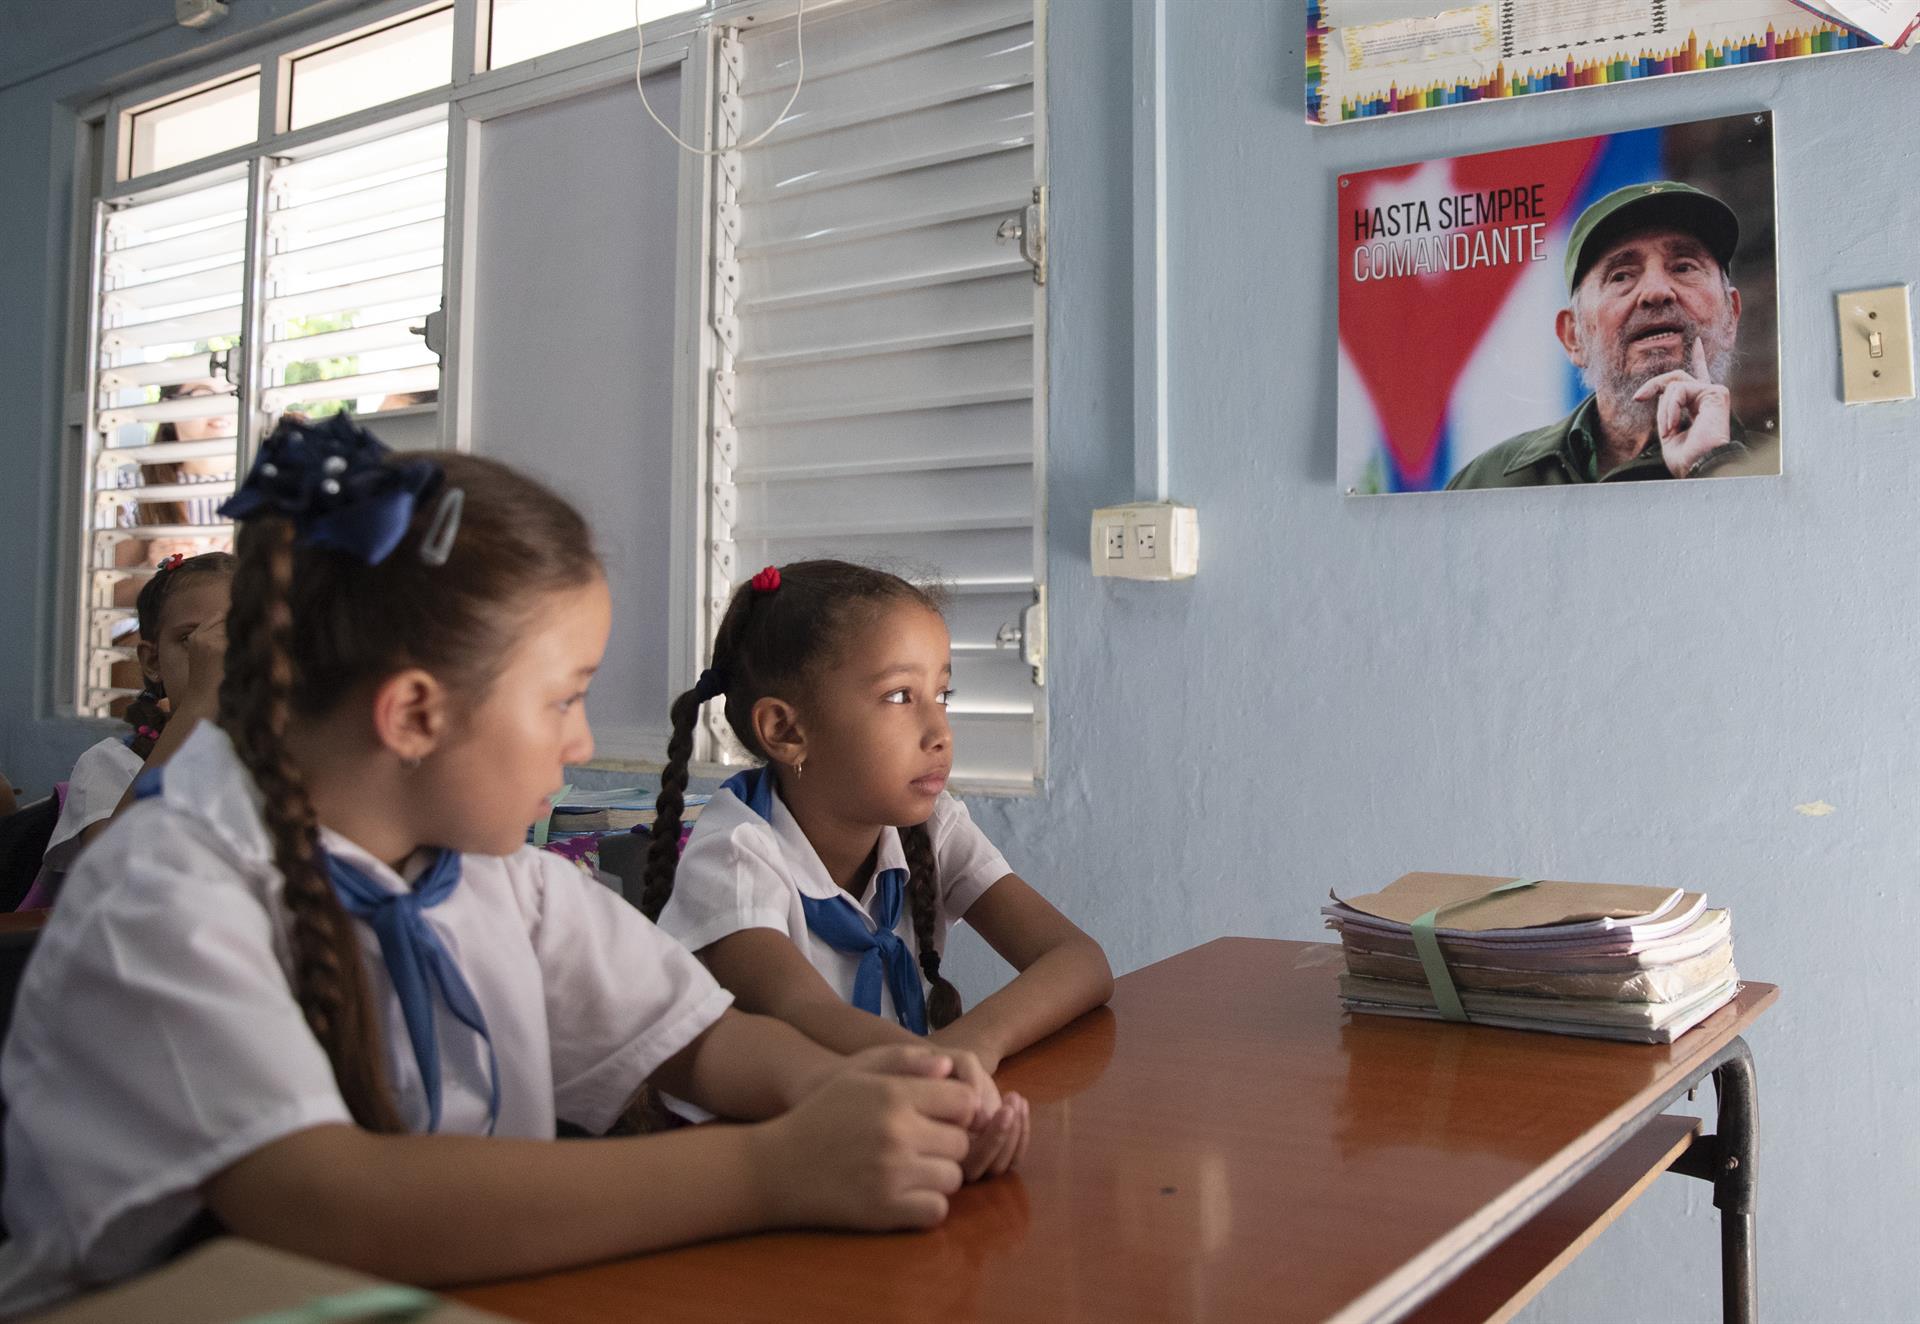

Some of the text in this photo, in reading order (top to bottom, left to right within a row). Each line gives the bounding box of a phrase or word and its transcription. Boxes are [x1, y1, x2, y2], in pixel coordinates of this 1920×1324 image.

[1354, 184, 1546, 241] HASTA SIEMPRE
[1353, 222, 1547, 283] COMANDANTE
